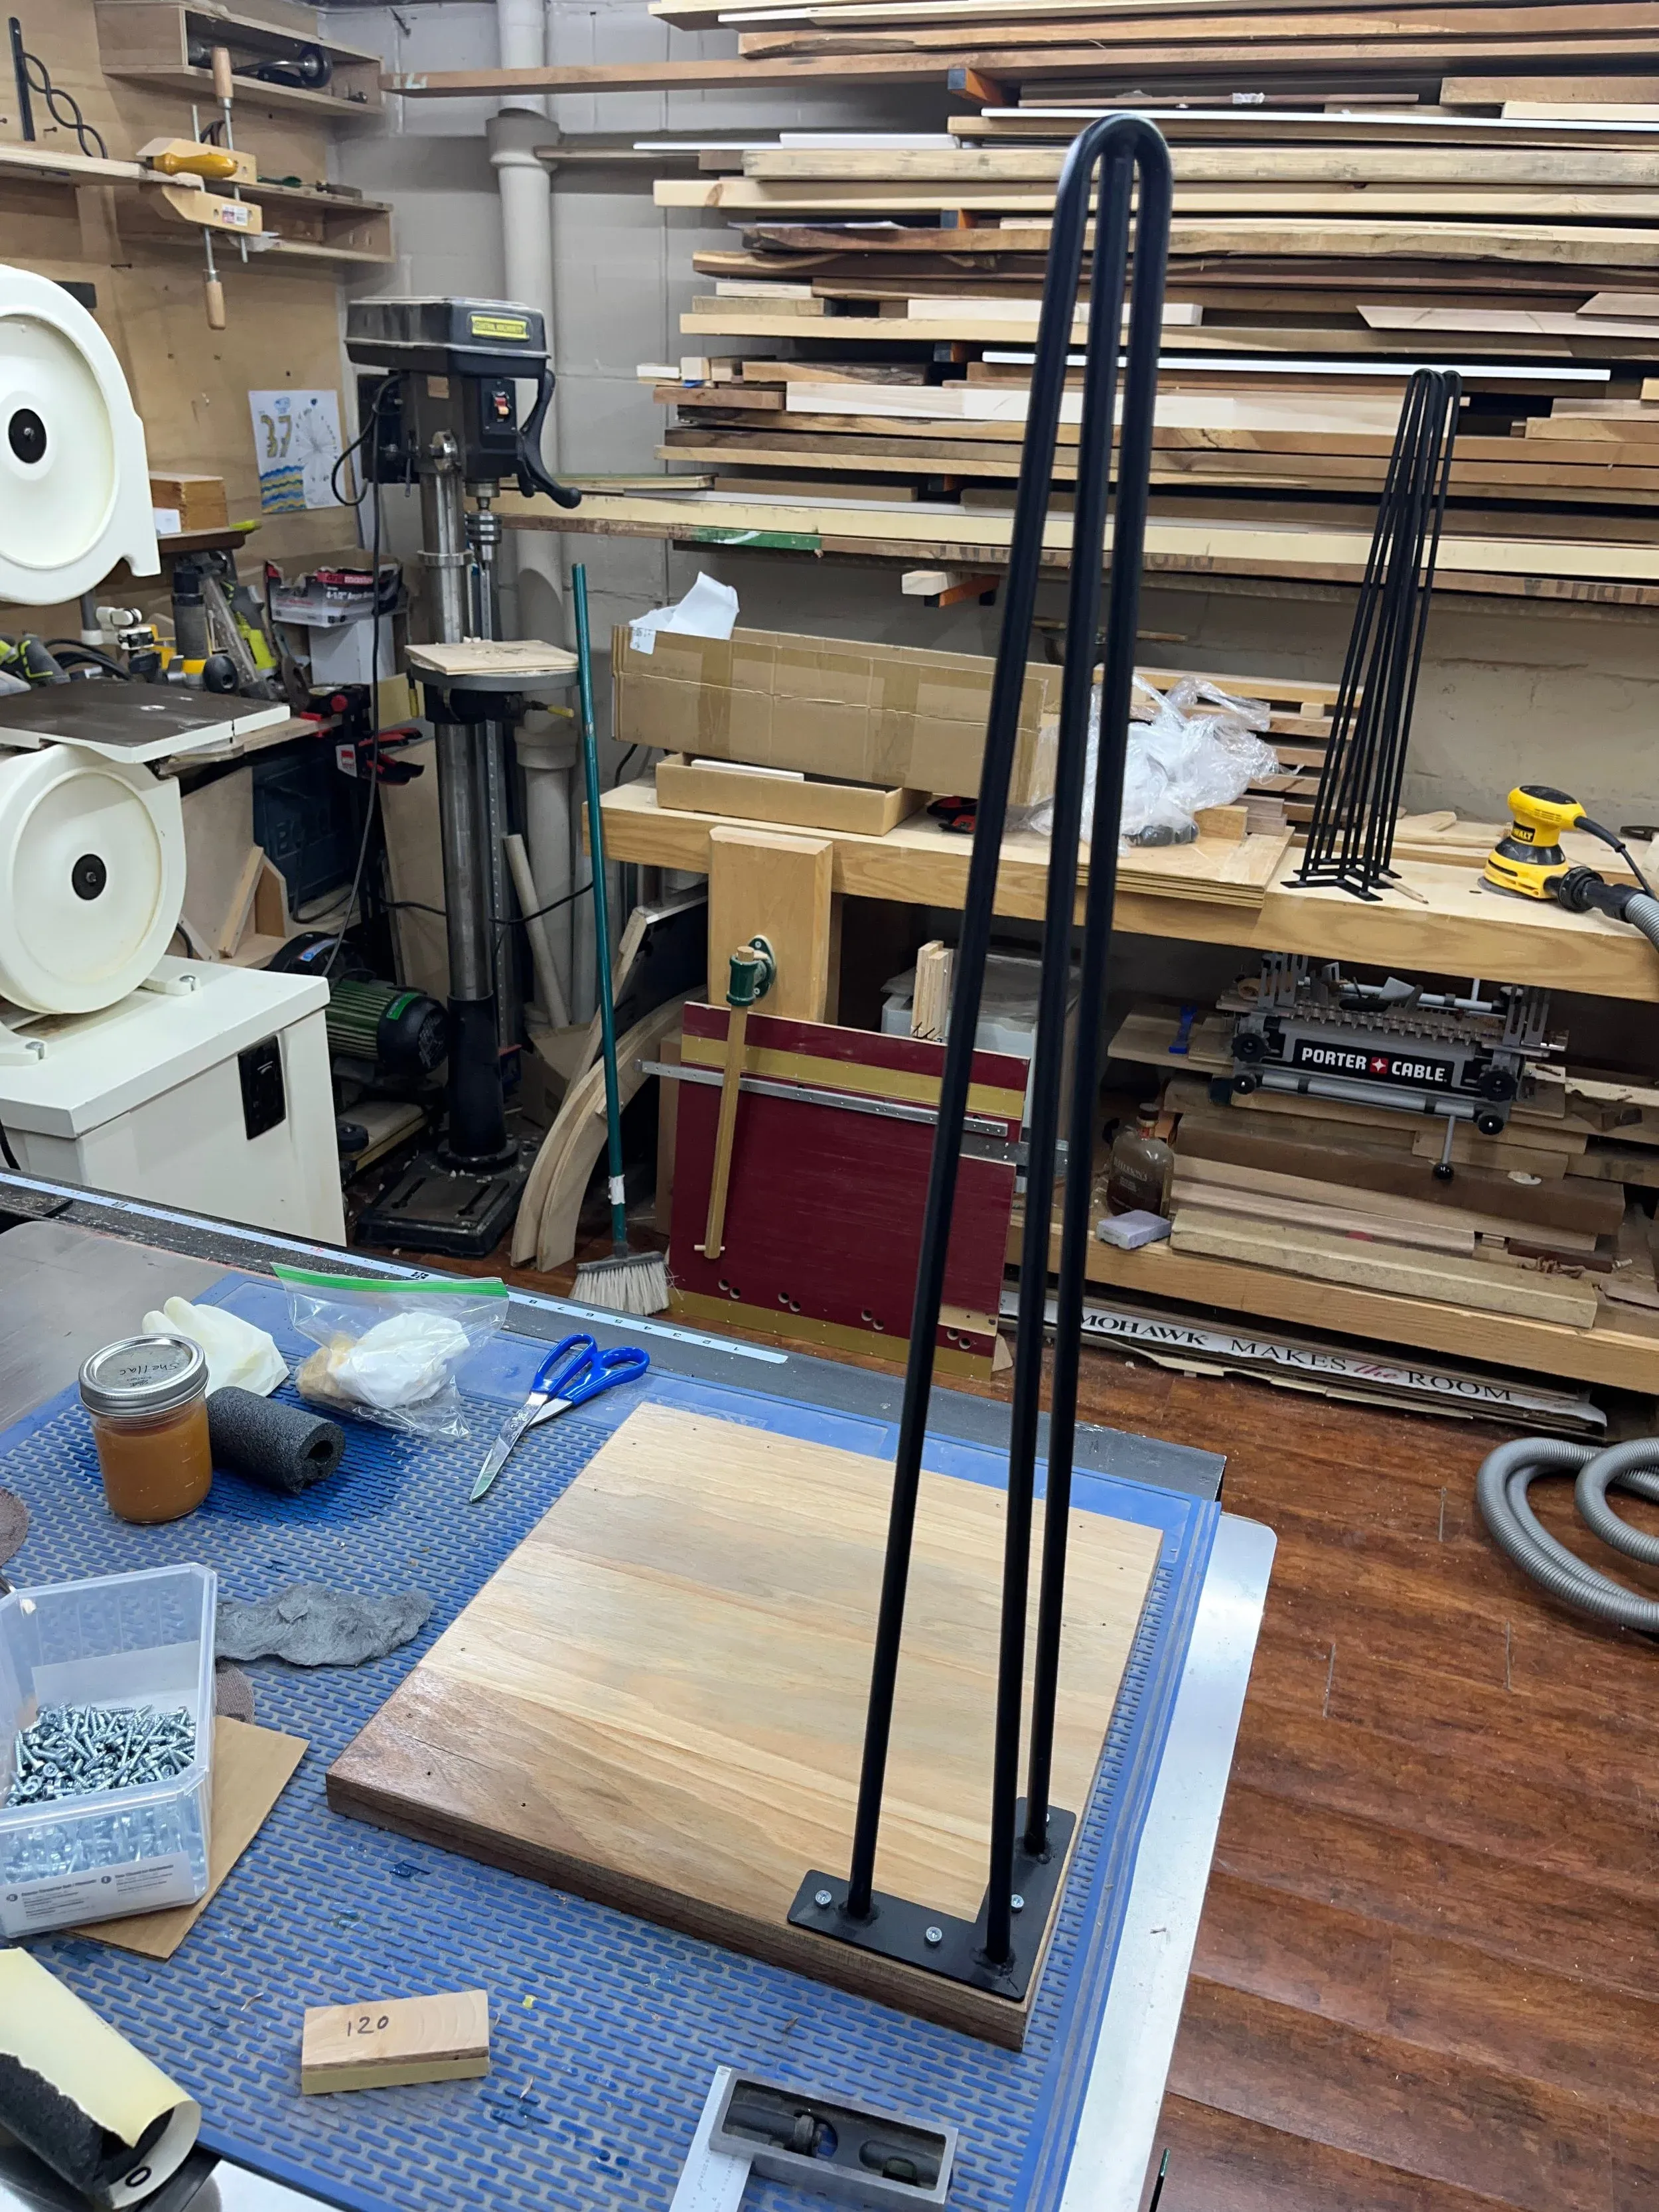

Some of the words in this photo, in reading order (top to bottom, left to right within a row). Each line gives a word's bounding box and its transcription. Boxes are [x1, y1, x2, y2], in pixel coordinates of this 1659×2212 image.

[1301, 1047, 1367, 1070] PORTER
[1392, 1061, 1445, 1082] CABLE
[1231, 1339, 1346, 1371] MAKES
[1353, 1364, 1399, 1380] the
[1407, 1370, 1510, 1401] ROOM
[347, 2015, 390, 2037] 120
